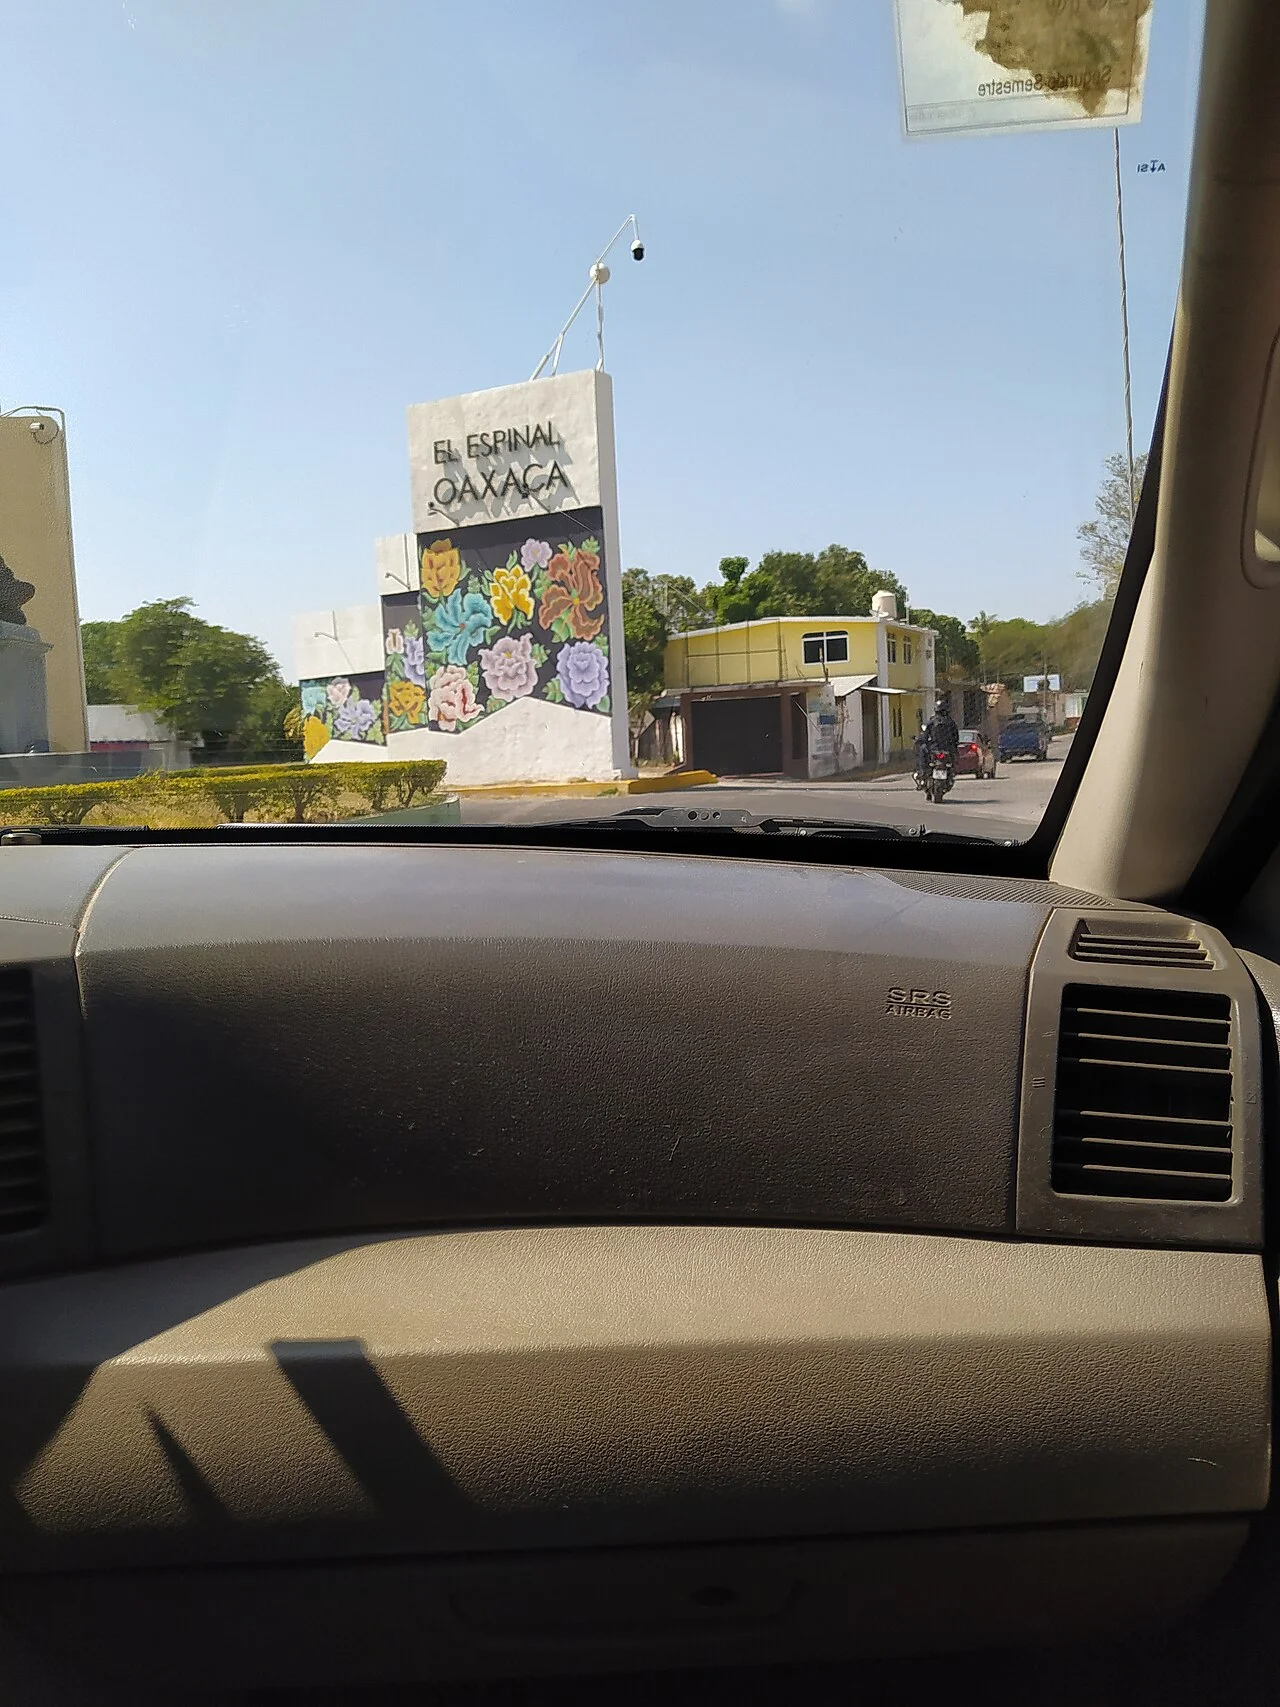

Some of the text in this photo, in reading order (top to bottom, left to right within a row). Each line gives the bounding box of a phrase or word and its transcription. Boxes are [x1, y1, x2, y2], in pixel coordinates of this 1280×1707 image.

[433, 420, 561, 465] EL ESPINAL
[433, 459, 569, 506] OAXACA
[885, 1004, 953, 1020] AIRBAG
[886, 986, 953, 1007] SRS
